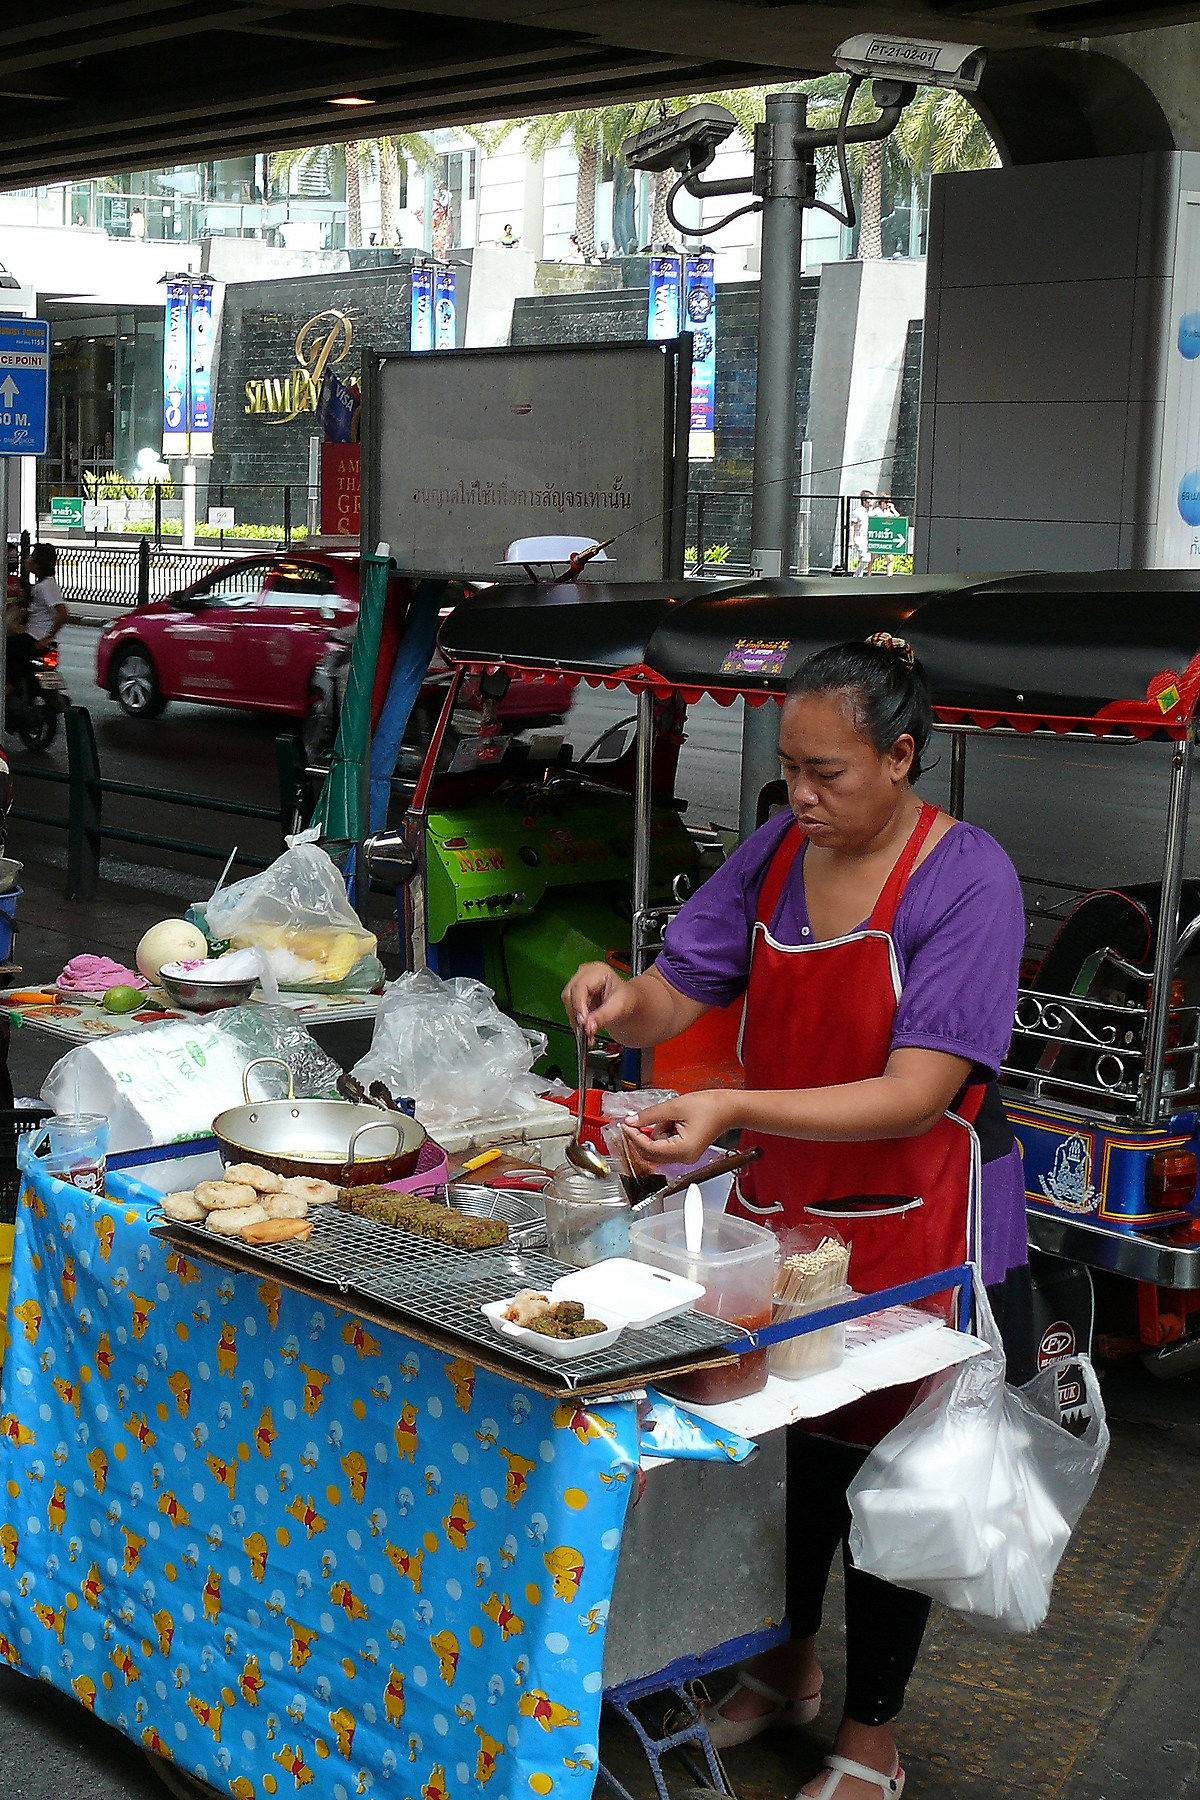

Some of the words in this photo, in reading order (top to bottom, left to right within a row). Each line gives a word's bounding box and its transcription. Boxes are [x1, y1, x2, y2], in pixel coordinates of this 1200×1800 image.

[869, 44, 935, 62] PT-21-02-01
[15, 356, 43, 366] POINT
[336, 387, 355, 412] VISA
[15, 413, 31, 427] M.
[455, 849, 506, 873] NEW
